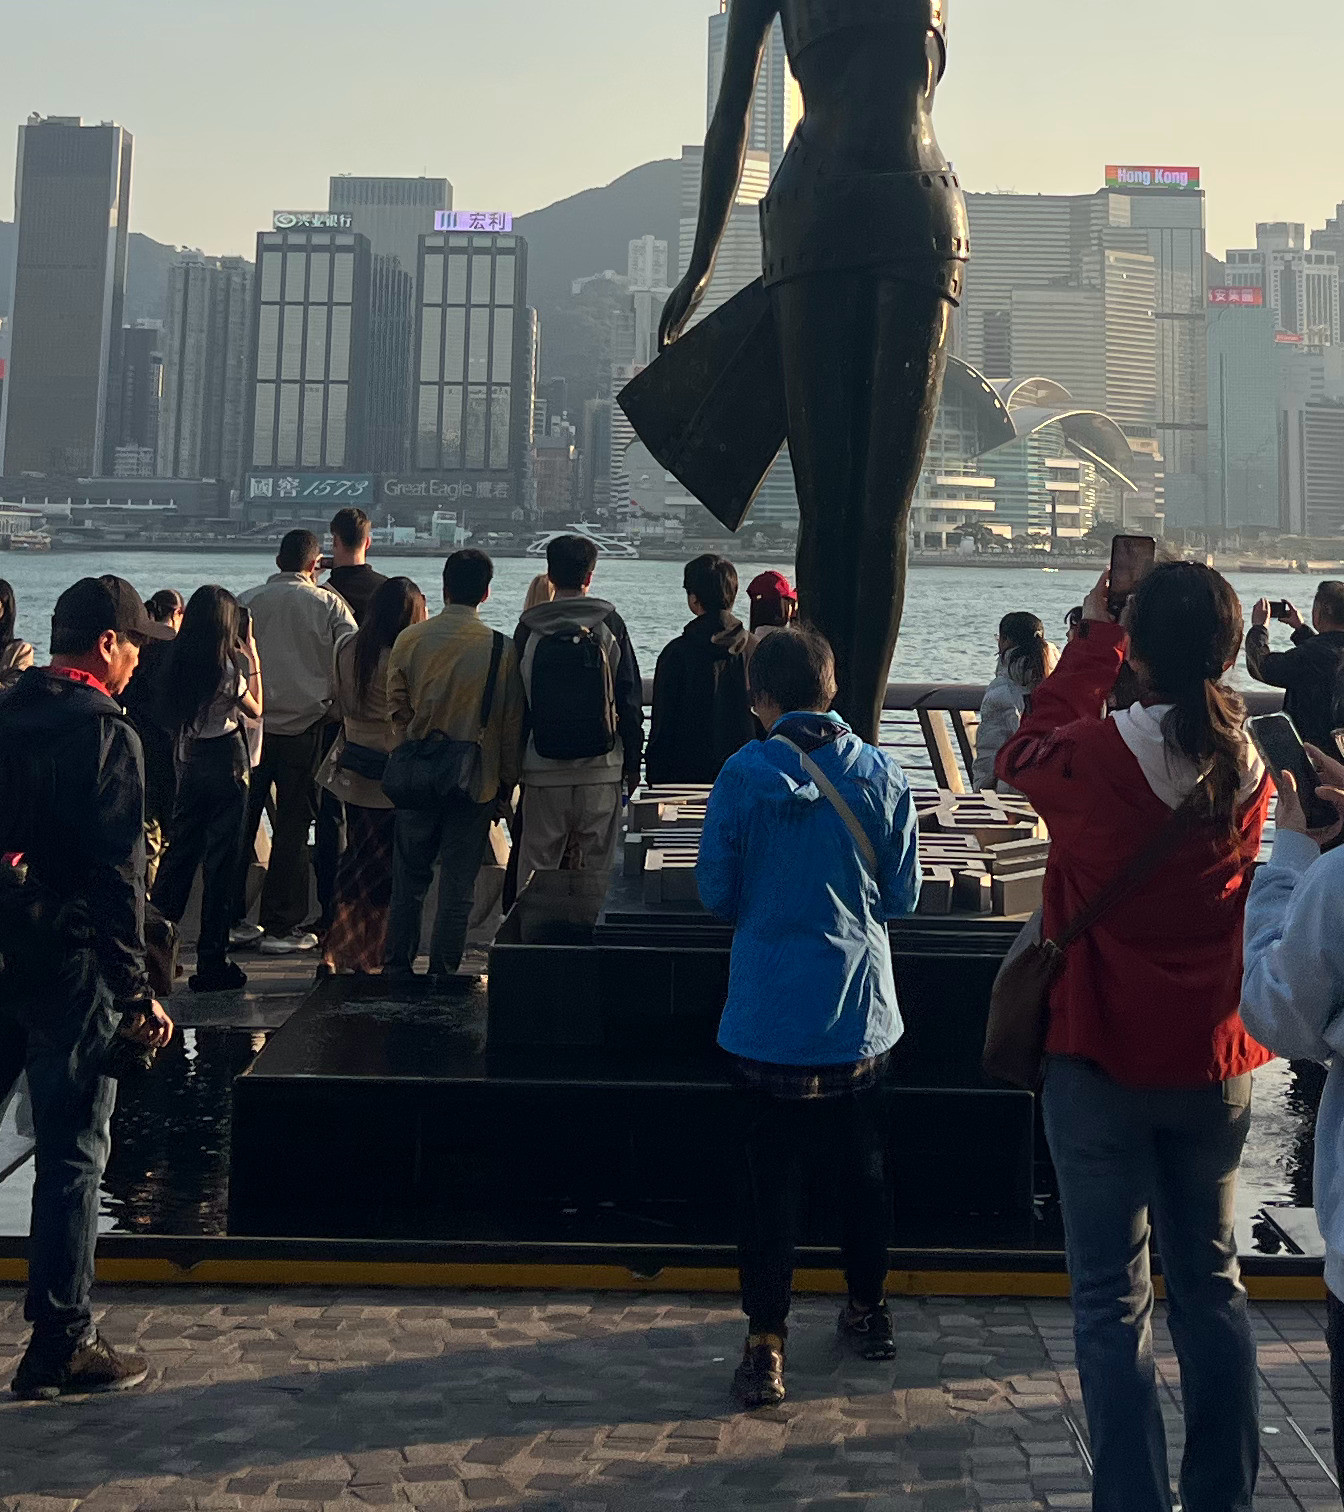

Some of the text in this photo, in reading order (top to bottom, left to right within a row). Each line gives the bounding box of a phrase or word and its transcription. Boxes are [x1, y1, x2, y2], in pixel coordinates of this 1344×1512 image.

[1117, 168, 1188, 186] Hong Kong
[296, 213, 352, 227] 兴业银行
[469, 212, 506, 230] 宏利
[384, 478, 428, 496] Great
[430, 479, 473, 501] Eagle
